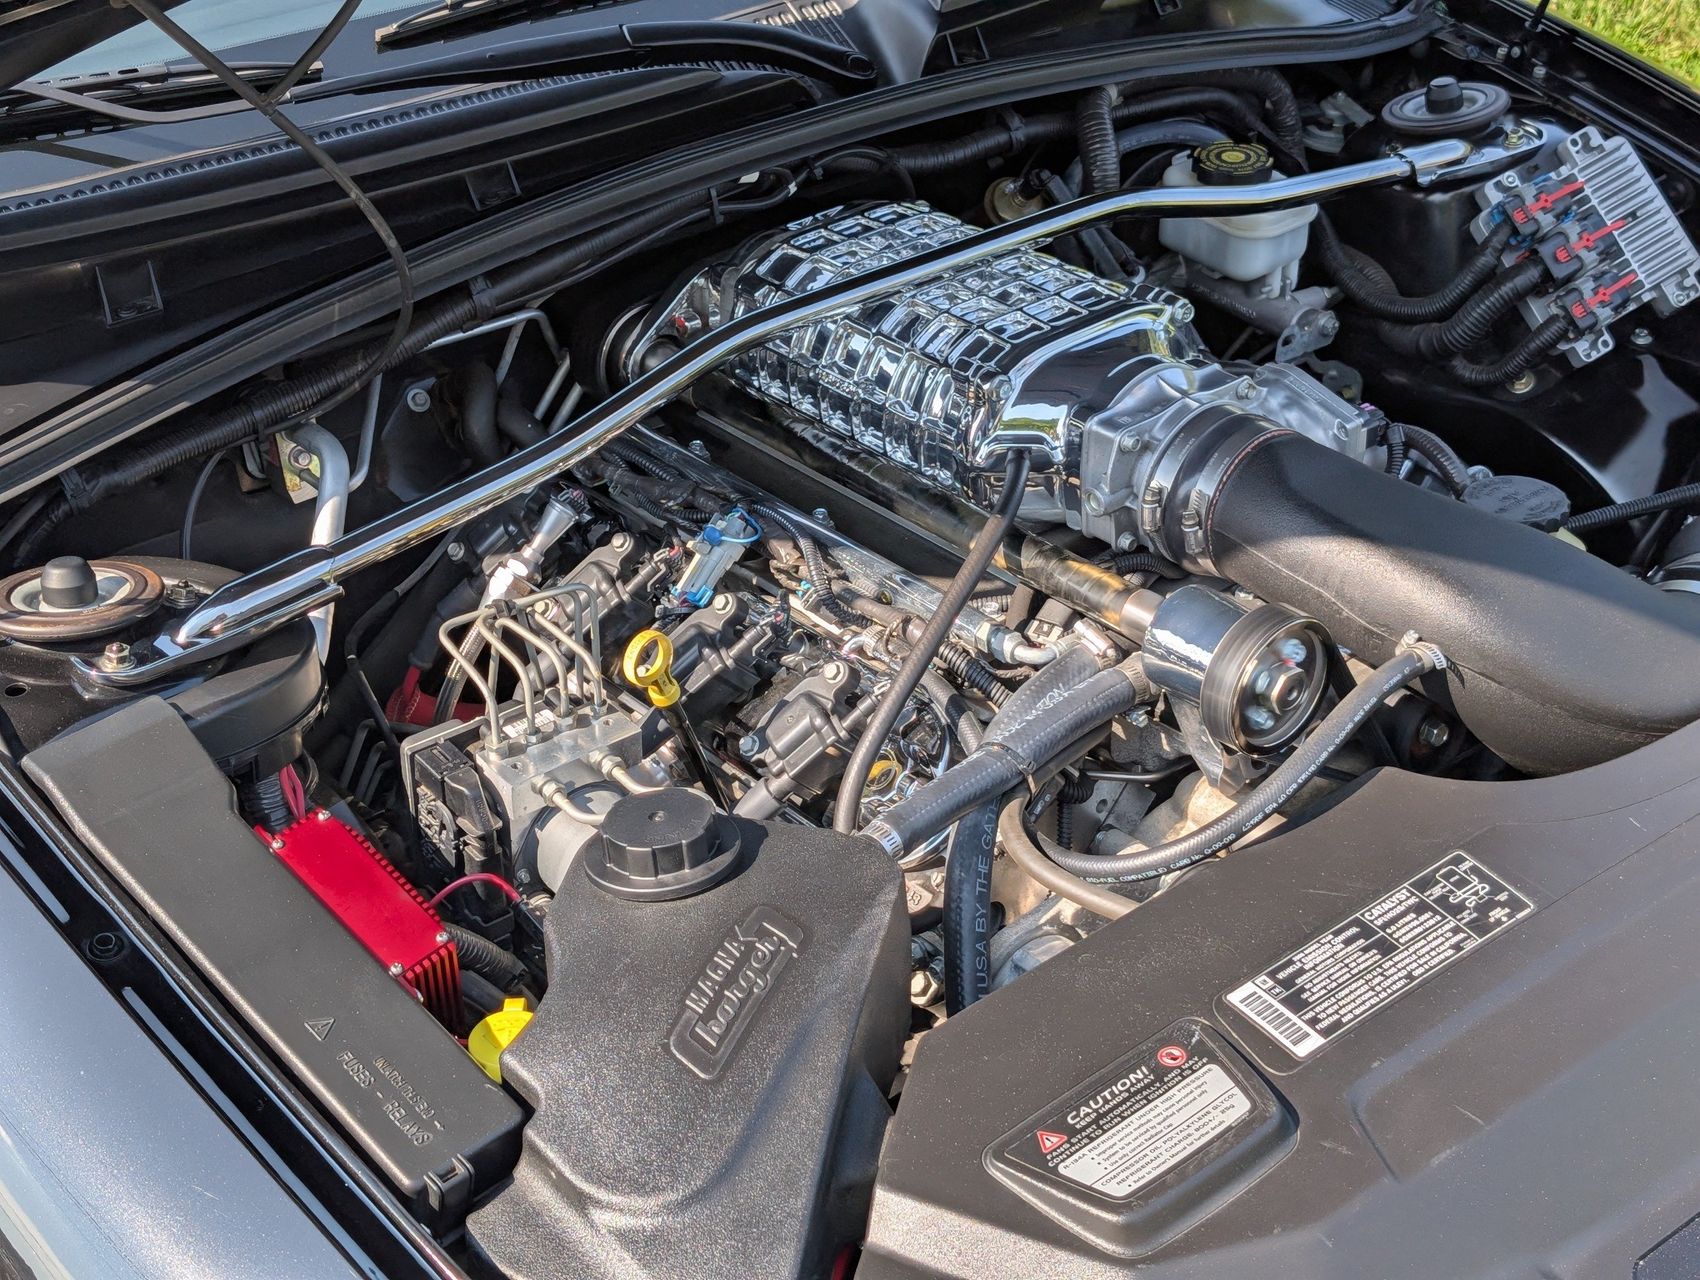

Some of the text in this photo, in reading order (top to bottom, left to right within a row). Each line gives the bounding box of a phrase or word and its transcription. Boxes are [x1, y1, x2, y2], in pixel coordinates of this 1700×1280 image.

[1263, 800, 1278, 814] EPA
[976, 855, 989, 896] THE
[976, 903, 987, 933] BY
[1364, 888, 1411, 920] CATALYST
[1385, 912, 1416, 933] 6.0 LITRES
[1275, 926, 1360, 979] VEHICLE EMISSION CONTROL
[1302, 942, 1344, 970] INFORMATION
[1315, 957, 1335, 970] MOTORS
[1319, 934, 1333, 943] YEAR
[686, 938, 744, 1014] MAGNA
[1300, 1010, 1315, 1020] THIS
[1313, 996, 1337, 1012] VEHICLE
[1334, 978, 1365, 999] CONFORMS
[1381, 960, 1394, 969] EPA
[1391, 939, 1427, 962] REGULATIONS
[1425, 920, 1456, 941] APPLICABLE
[1314, 1013, 1340, 1030] FEDERAL
[1380, 969, 1407, 987] CERTIFIED
[1405, 961, 1418, 971] FOR
[1416, 953, 1431, 964] SALE
[1324, 1003, 1339, 1014] NEW
[1337, 984, 1370, 1006] PASSENGER
[1383, 966, 1397, 976] THIS
[1395, 953, 1418, 968] VEHICLE
[1416, 936, 1445, 956] CONFORMS
[1326, 981, 1338, 990] FOR
[1340, 1012, 1354, 1023] AND
[1352, 996, 1380, 1015] QUALIFIES
[1378, 991, 1388, 999] AS
[336, 1050, 376, 1088] FUSES
[383, 1100, 433, 1146] RELAYS
[1046, 1142, 1070, 1159] FANS
[1070, 1123, 1097, 1143] START
[1163, 1068, 1180, 1082] AND
[1180, 1055, 1198, 1069] MAY
[1047, 1137, 1089, 1166] CONTINUE
[1089, 1129, 1102, 1137] TO
[1102, 1116, 1121, 1129] RUN
[1120, 1099, 1147, 1116] WHEN
[1147, 1075, 1182, 1100] IGNITION
[1192, 1057, 1208, 1069] OFF
[1062, 1067, 1213, 1169] R-134A REFRIGERANT UNDER HIGH PRESSURE
[1066, 1065, 1148, 1124] CAUTION!
[1074, 1073, 1154, 1128] KEEP HANDS AWAY
[1095, 1141, 1117, 1157] Improper
[1117, 1130, 1133, 1142] service
[1132, 1118, 1153, 1131] methods
[1152, 1111, 1163, 1119] may
[1174, 1088, 1194, 1104] personal
[1193, 1080, 1207, 1090] injury
[1100, 1152, 1149, 1186] COMPRESSOR
[1162, 1109, 1211, 1144] POLYALKYLENE
[1211, 1092, 1237, 1110] GLYCOL
[1101, 1149, 1119, 1162] System
[1131, 1127, 1150, 1142] serviced
[1155, 1110, 1176, 1125] qualified
[1196, 1089, 1207, 1097] only
[1117, 1152, 1129, 1160] only
[1128, 1140, 1145, 1153] correct
[1143, 1128, 1163, 1142] Radiator
[1132, 1174, 1145, 1184] Refer
[1168, 1145, 1187, 1158] Manual
[1193, 1129, 1210, 1141] further
[1210, 1119, 1225, 1131] details
[1115, 1151, 1163, 1185] REFRIGERANT
